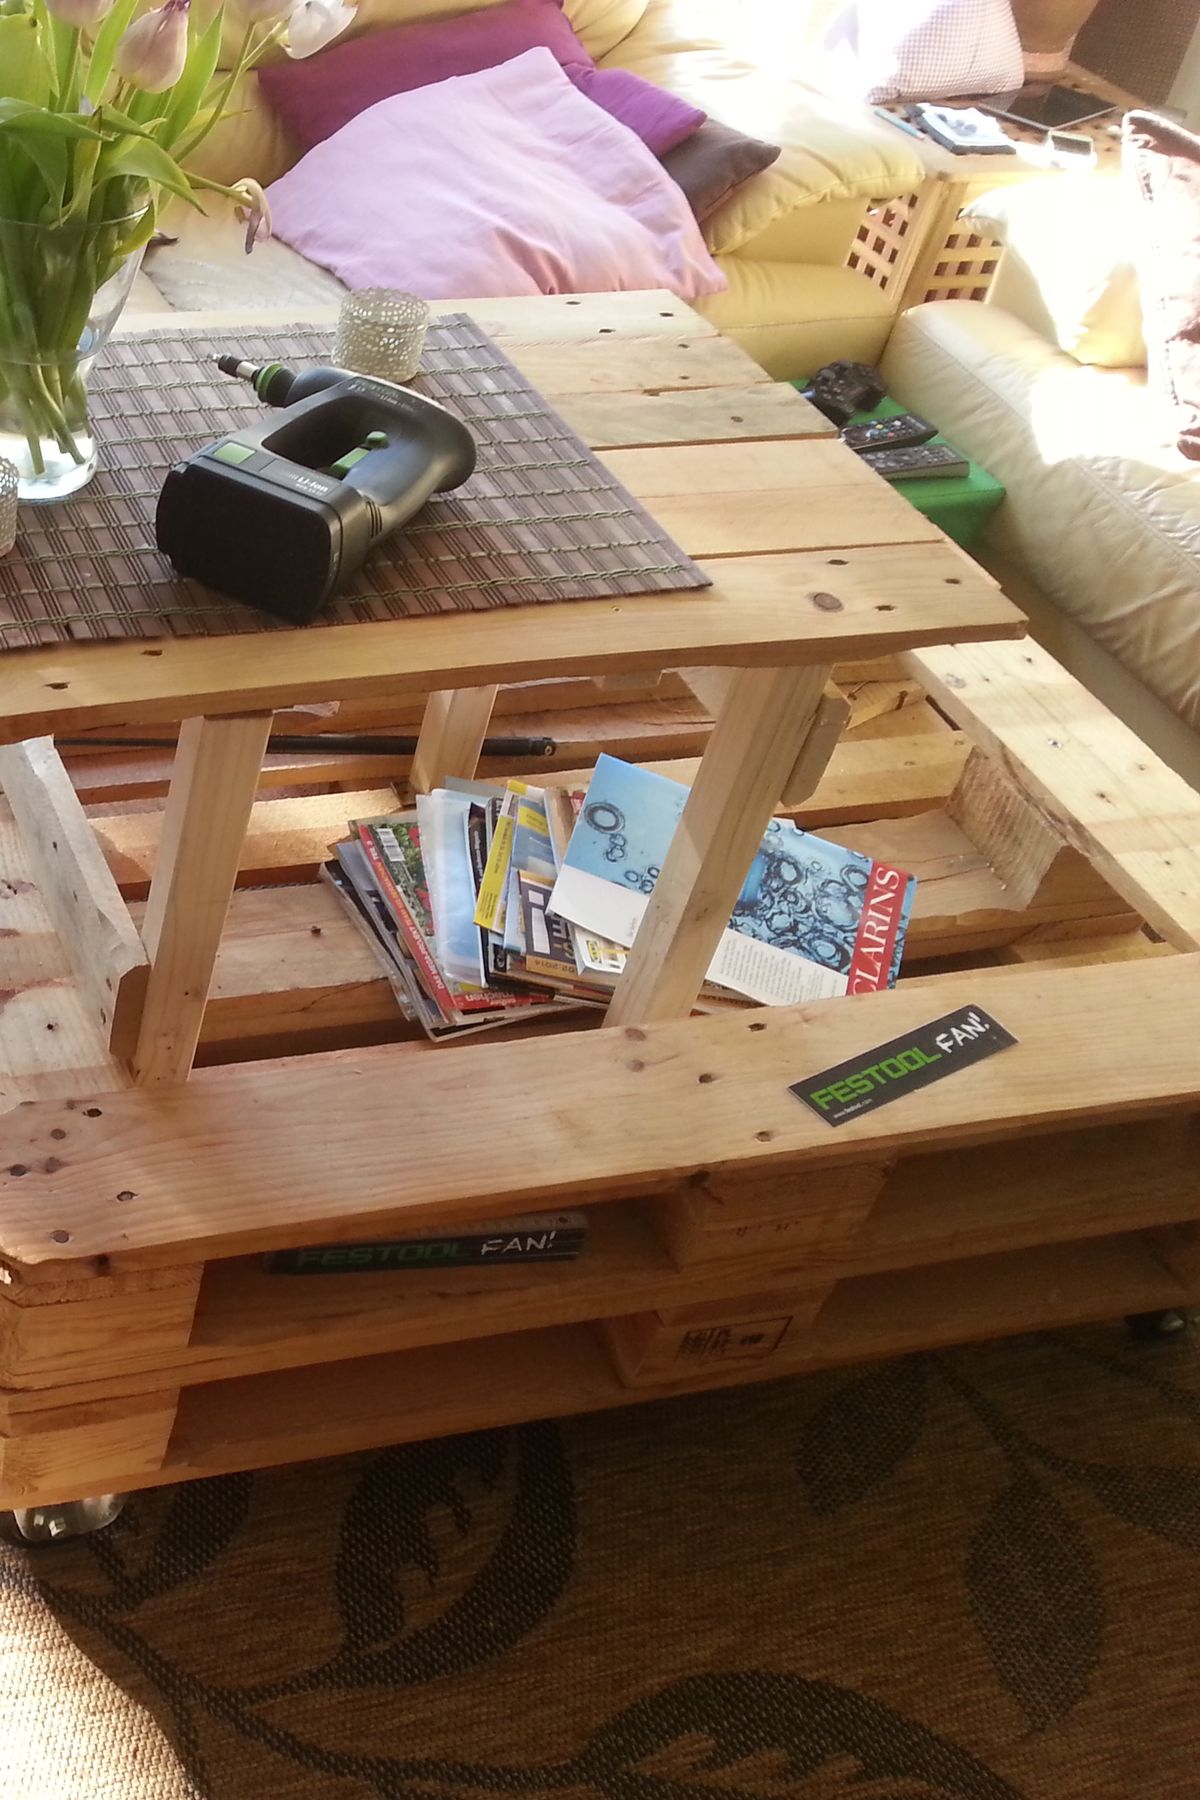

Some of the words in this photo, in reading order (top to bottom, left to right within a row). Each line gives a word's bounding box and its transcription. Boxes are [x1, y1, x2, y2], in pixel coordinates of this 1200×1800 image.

[852, 866, 901, 997] CLARINS
[809, 1047, 943, 1110] FESTOOL
[935, 1011, 991, 1054] FAN!
[295, 1242, 471, 1269] FESTOOL
[481, 1230, 557, 1257] FAN!
